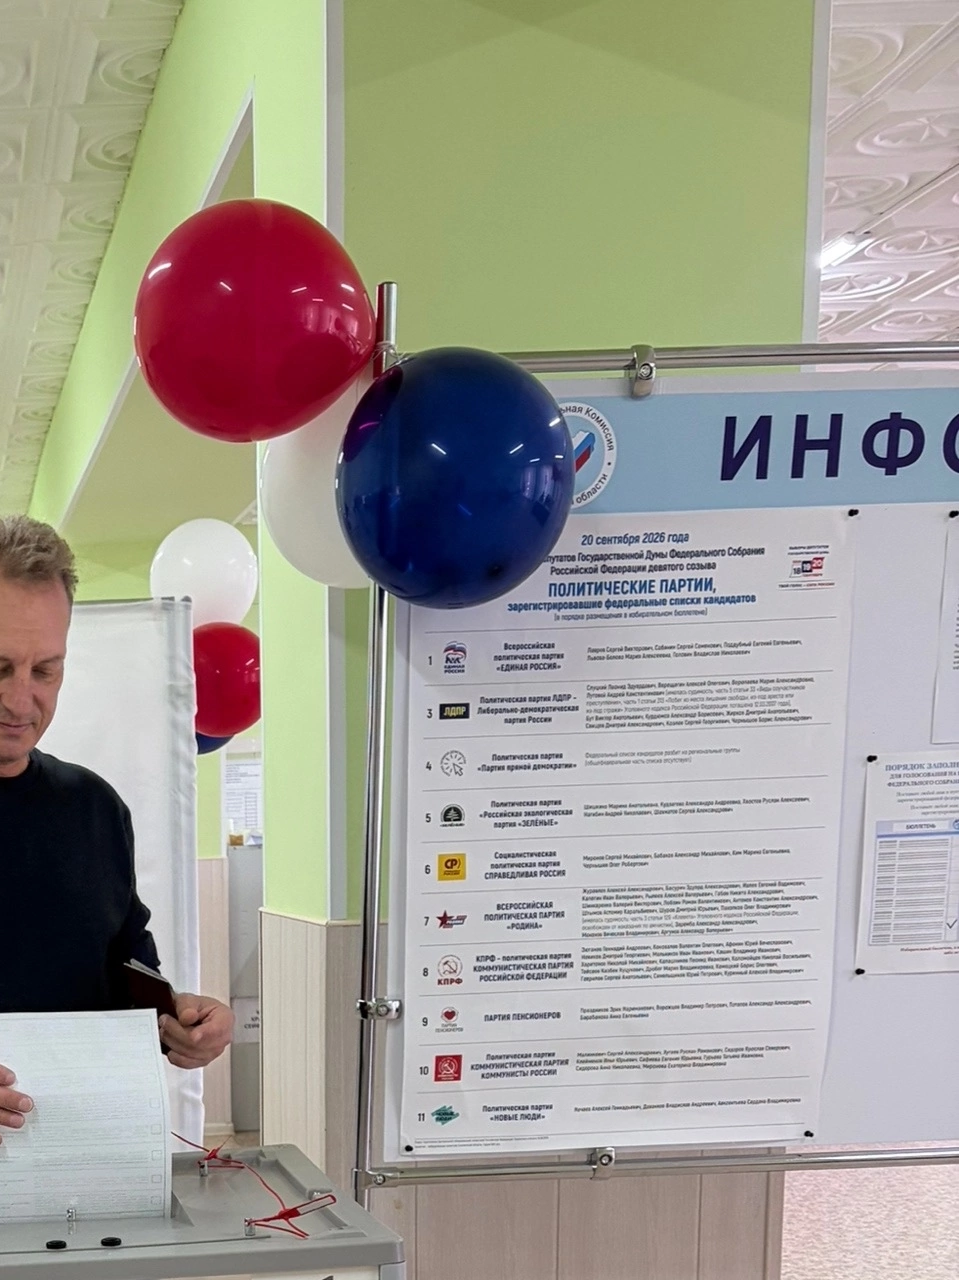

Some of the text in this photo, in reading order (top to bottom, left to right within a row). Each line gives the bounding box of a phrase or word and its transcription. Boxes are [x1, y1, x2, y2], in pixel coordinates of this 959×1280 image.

[584, 407, 614, 452] Комиссия
[720, 411, 959, 481] ИНФ
[576, 473, 608, 504] области
[581, 532, 689, 546] 20 сентября 2026 года
[578, 551, 644, 562] Государственной
[646, 550, 668, 561] Думы
[670, 549, 726, 559] Федерального
[728, 546, 765, 556] Собрания
[551, 565, 599, 575] Российской
[600, 564, 647, 574] Федерации
[649, 564, 684, 573] девятого
[549, 578, 716, 597] ПОЛИТИЧЕСКИЕ ПАРТИИ,
[508, 600, 603, 612] зарегистрировавшие
[605, 598, 667, 609] федеральные
[704, 595, 756, 605] кандидатов
[428, 656, 433, 665] 1
[497, 664, 528, 672] «ЕДИНАЯ
[427, 708, 433, 718] 3
[444, 706, 466, 716] ЛДПР
[478, 706, 579, 714] Либерально-демократическая
[426, 761, 432, 771] 4
[425, 813, 431, 823] 5
[425, 865, 431, 874] 6
[485, 871, 538, 880] СПРАВЕДЛИВАЯ
[497, 902, 553, 910] ВСЕРОССИЙСКАЯ
[424, 917, 429, 926] 7
[484, 913, 538, 921] ПОЛИТИЧЕСКАЯ
[474, 963, 546, 972] КОММУНИСТИЧЕСКАЯ
[422, 968, 428, 977] 8
[480, 972, 567, 982] РОССИЙСКОЙ ФЕДЕРАЦИИ
[422, 1017, 428, 1026] 9
[534, 1052, 556, 1060] партия
[471, 1061, 542, 1070] КОММУНИСТИЧЕСКАЯ
[419, 1066, 429, 1075] 10
[482, 1071, 529, 1079] КОММУНИСТЫ
[418, 1113, 425, 1122] 11
